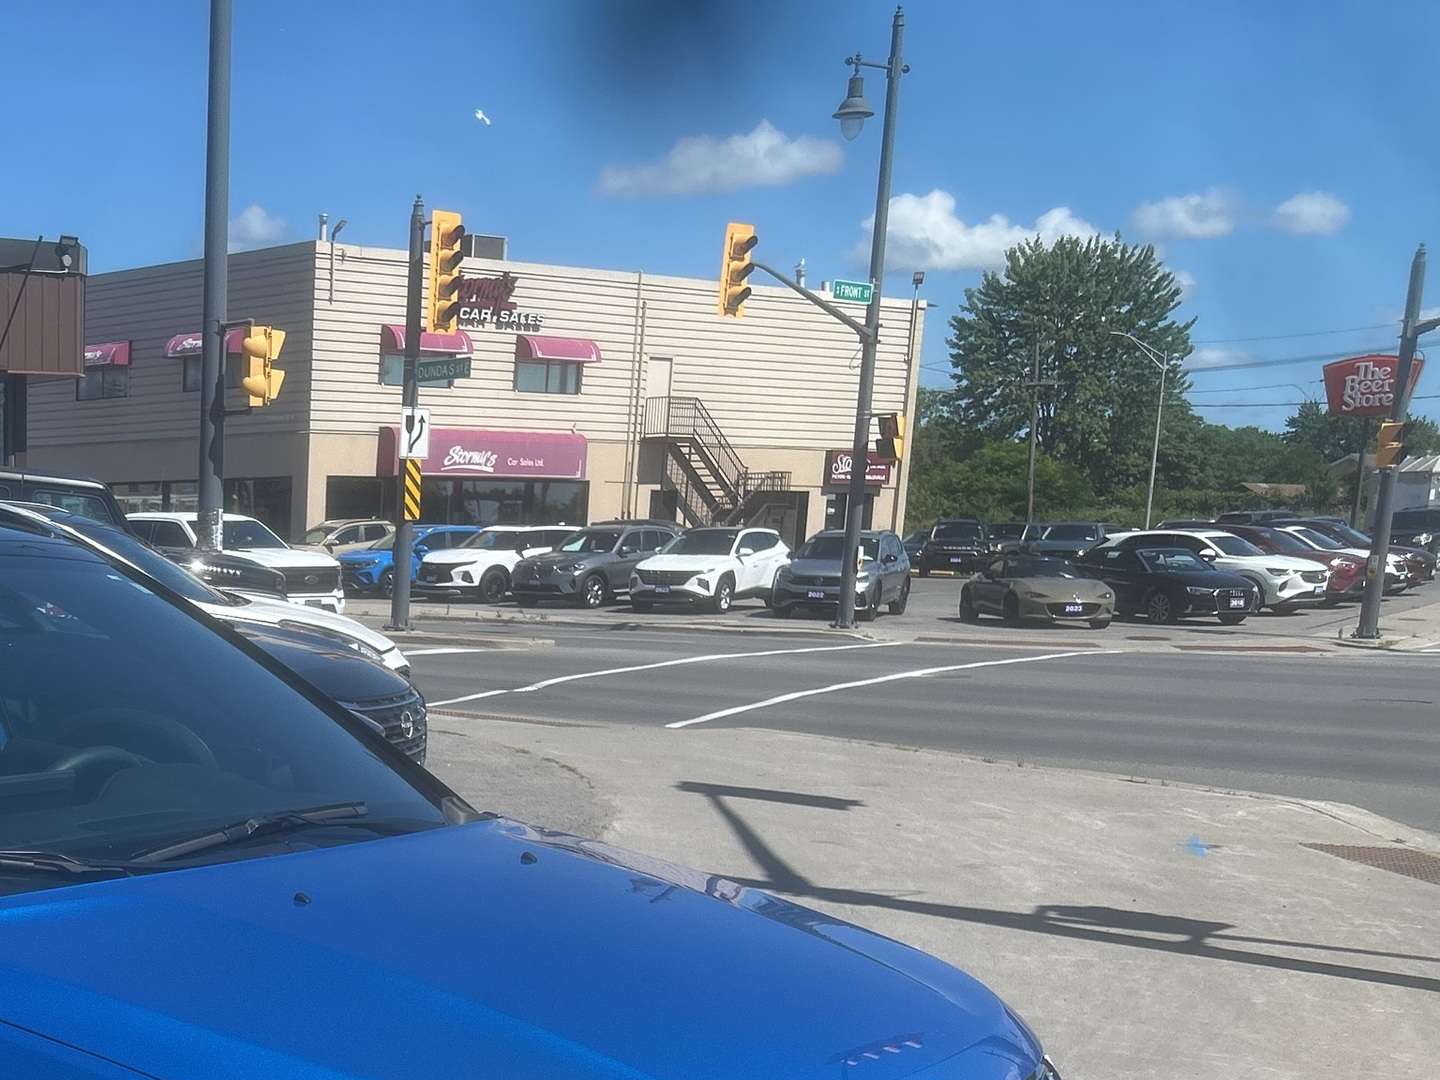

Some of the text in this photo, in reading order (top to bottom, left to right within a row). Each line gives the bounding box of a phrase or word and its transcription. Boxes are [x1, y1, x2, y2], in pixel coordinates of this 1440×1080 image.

[840, 284, 863, 299] FRONT
[460, 307, 545, 325] CAR SALES
[418, 363, 455, 378] DUNDAS
[1354, 361, 1392, 380] The
[1343, 375, 1395, 394] Beer
[1342, 391, 1395, 411] Store
[507, 457, 518, 466] Car
[519, 458, 535, 467] Sales
